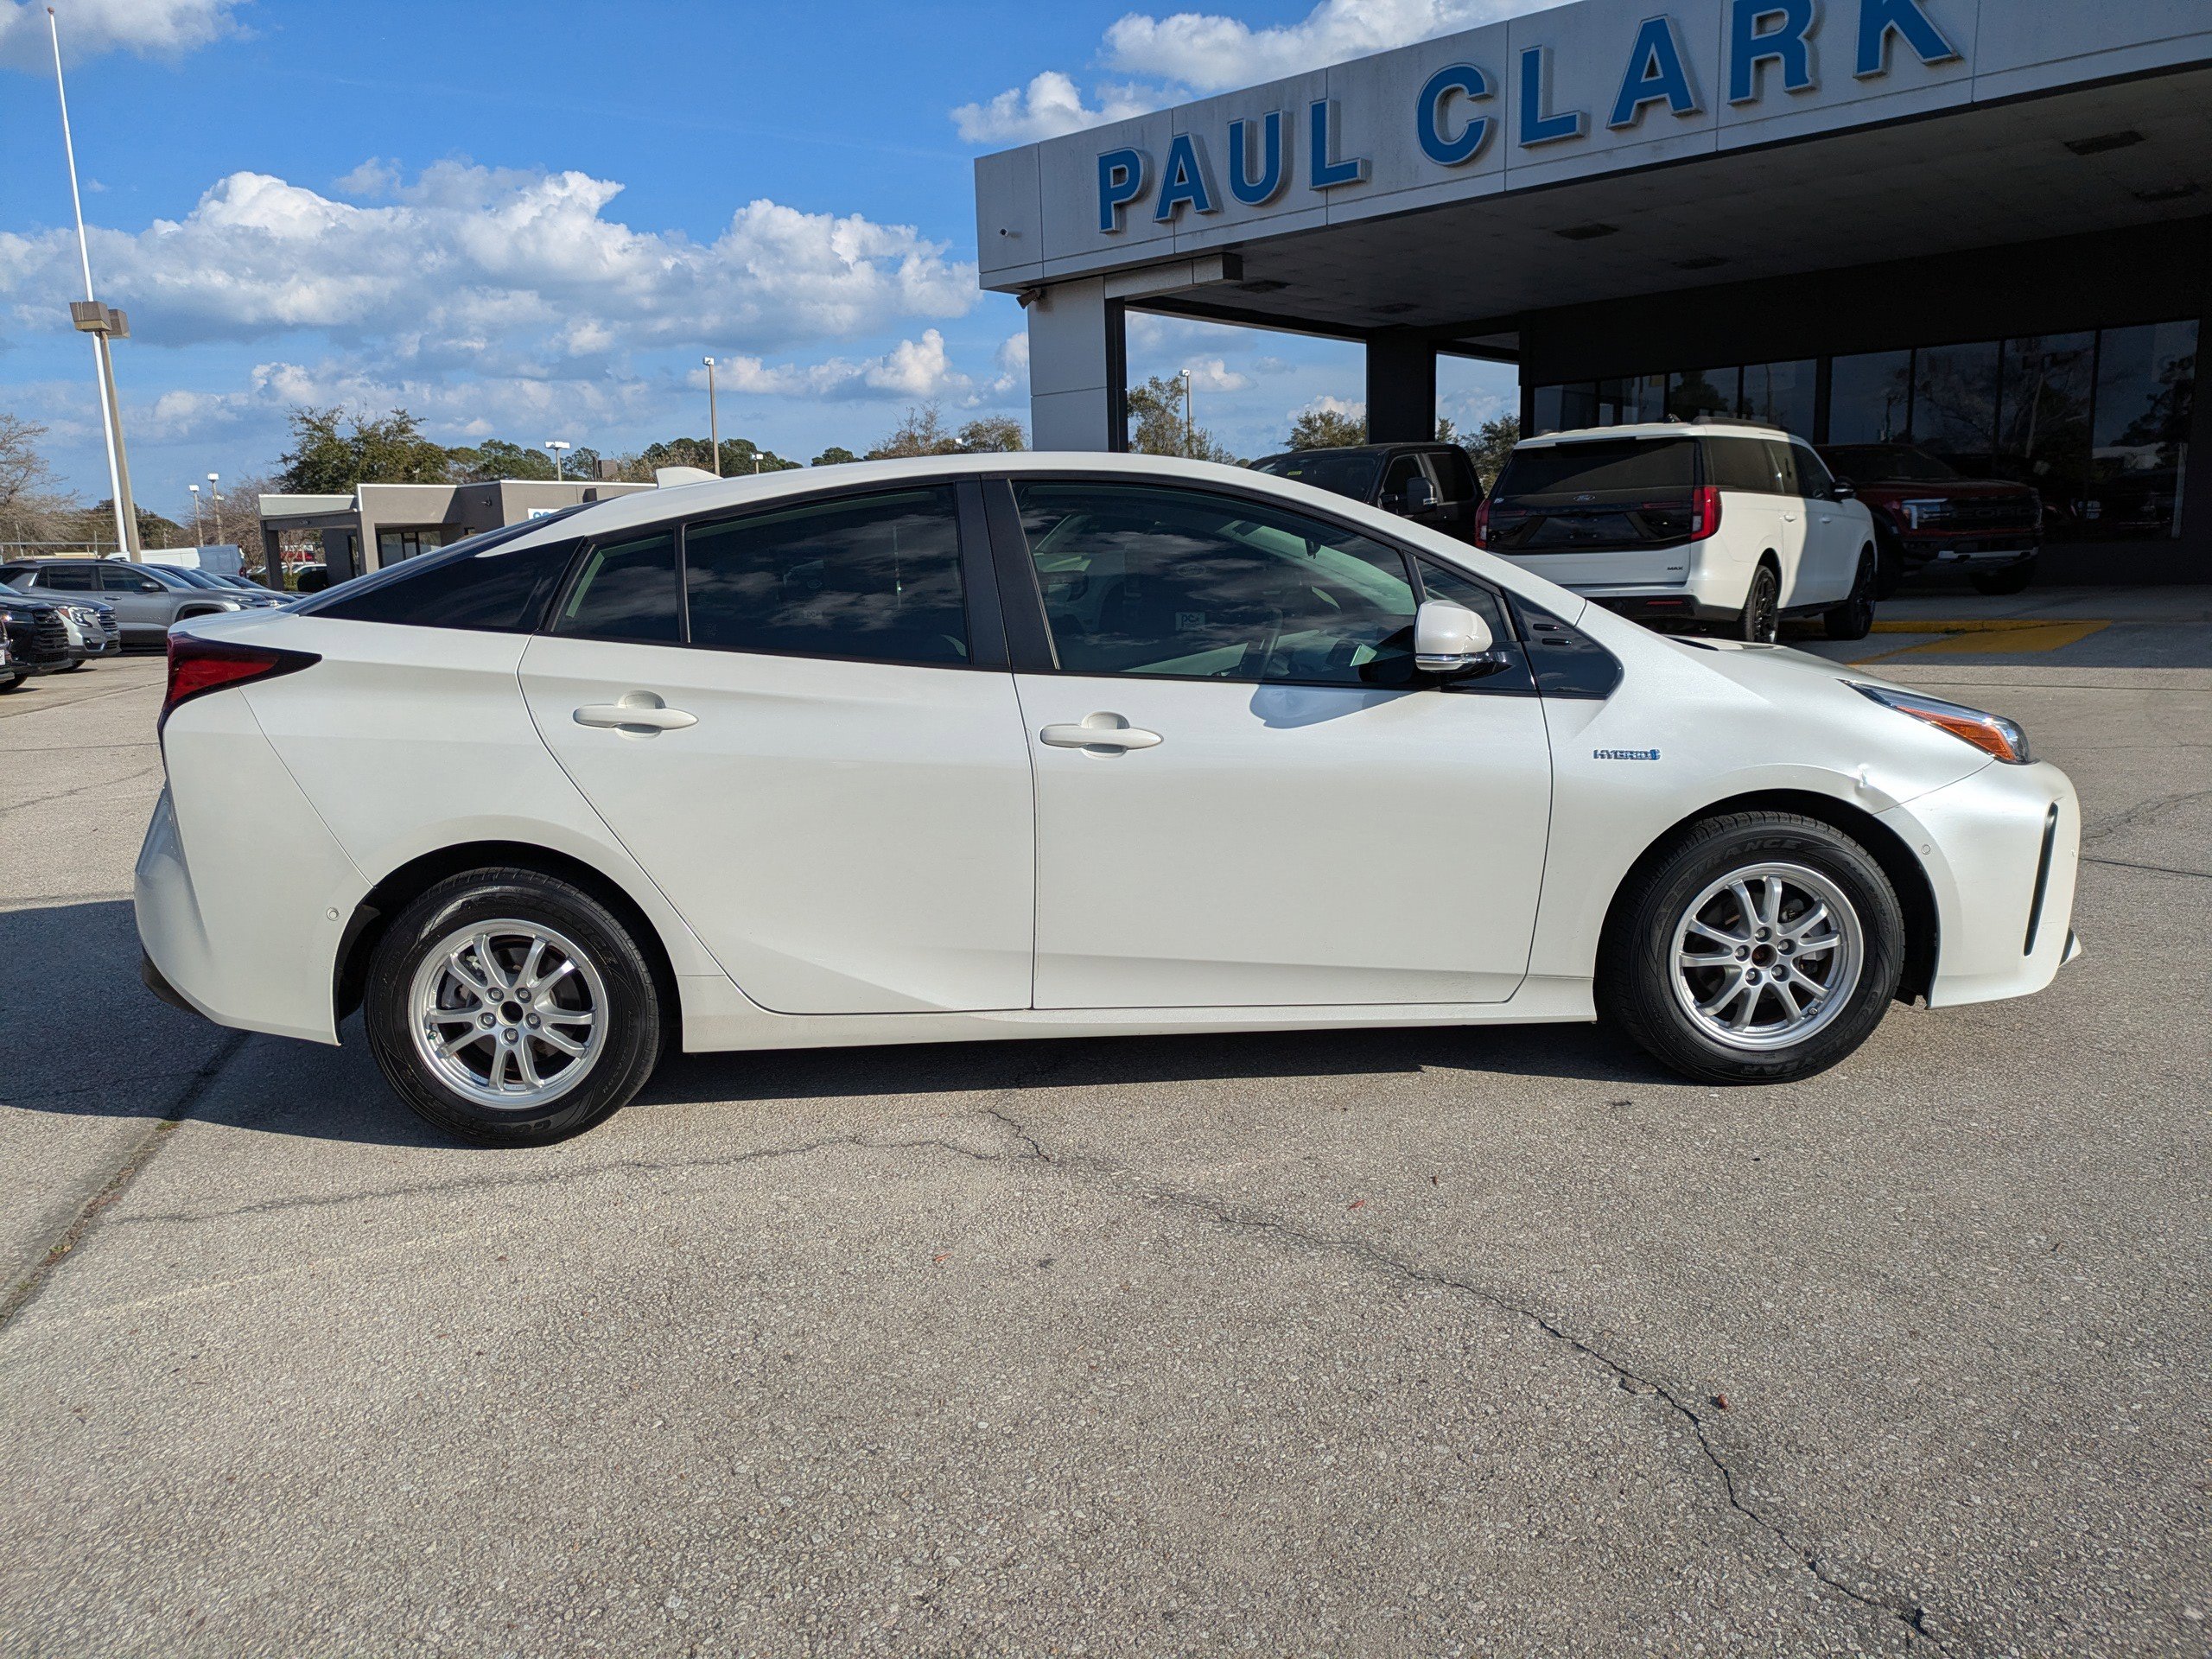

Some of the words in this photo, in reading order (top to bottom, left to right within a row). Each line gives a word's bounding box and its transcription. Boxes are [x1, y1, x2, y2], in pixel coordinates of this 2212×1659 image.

[1096, 98, 1371, 234] PAUL
[1415, 0, 1963, 168] CLARK
[1592, 749, 1649, 760] HYBRID
